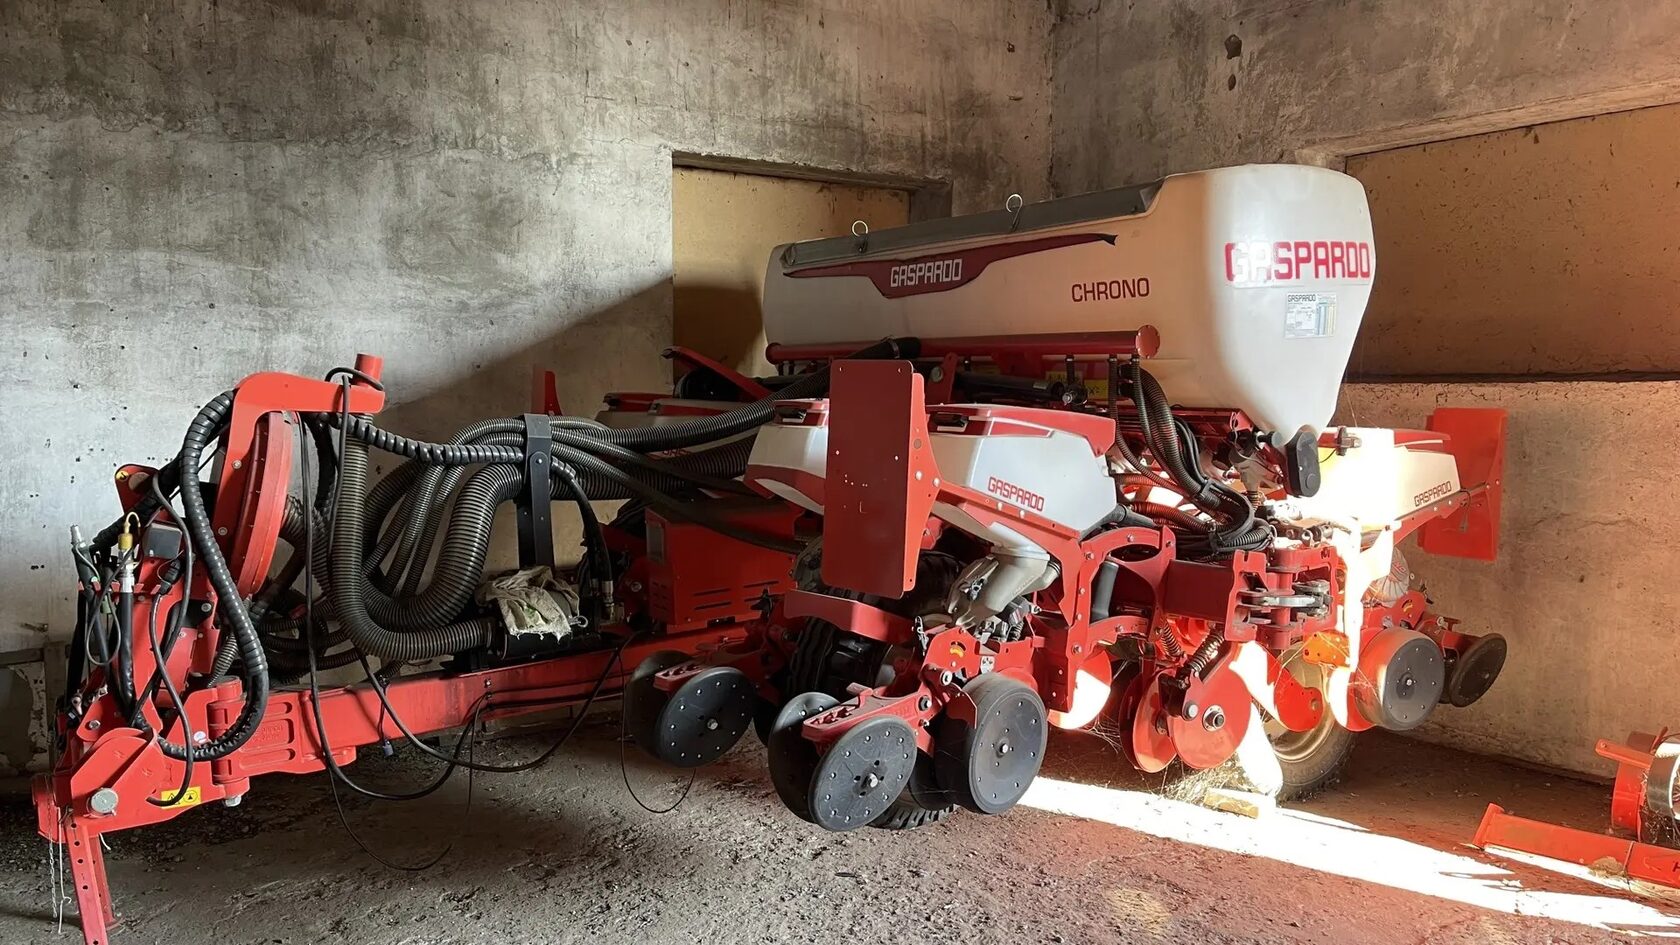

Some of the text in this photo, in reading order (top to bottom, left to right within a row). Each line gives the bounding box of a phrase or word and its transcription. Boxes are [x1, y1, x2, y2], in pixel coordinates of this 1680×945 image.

[890, 259, 962, 287] GASPARDO
[1071, 277, 1149, 302] CHRONO
[987, 476, 1045, 512] GASPARDO
[1414, 480, 1452, 507] GASPARDO
